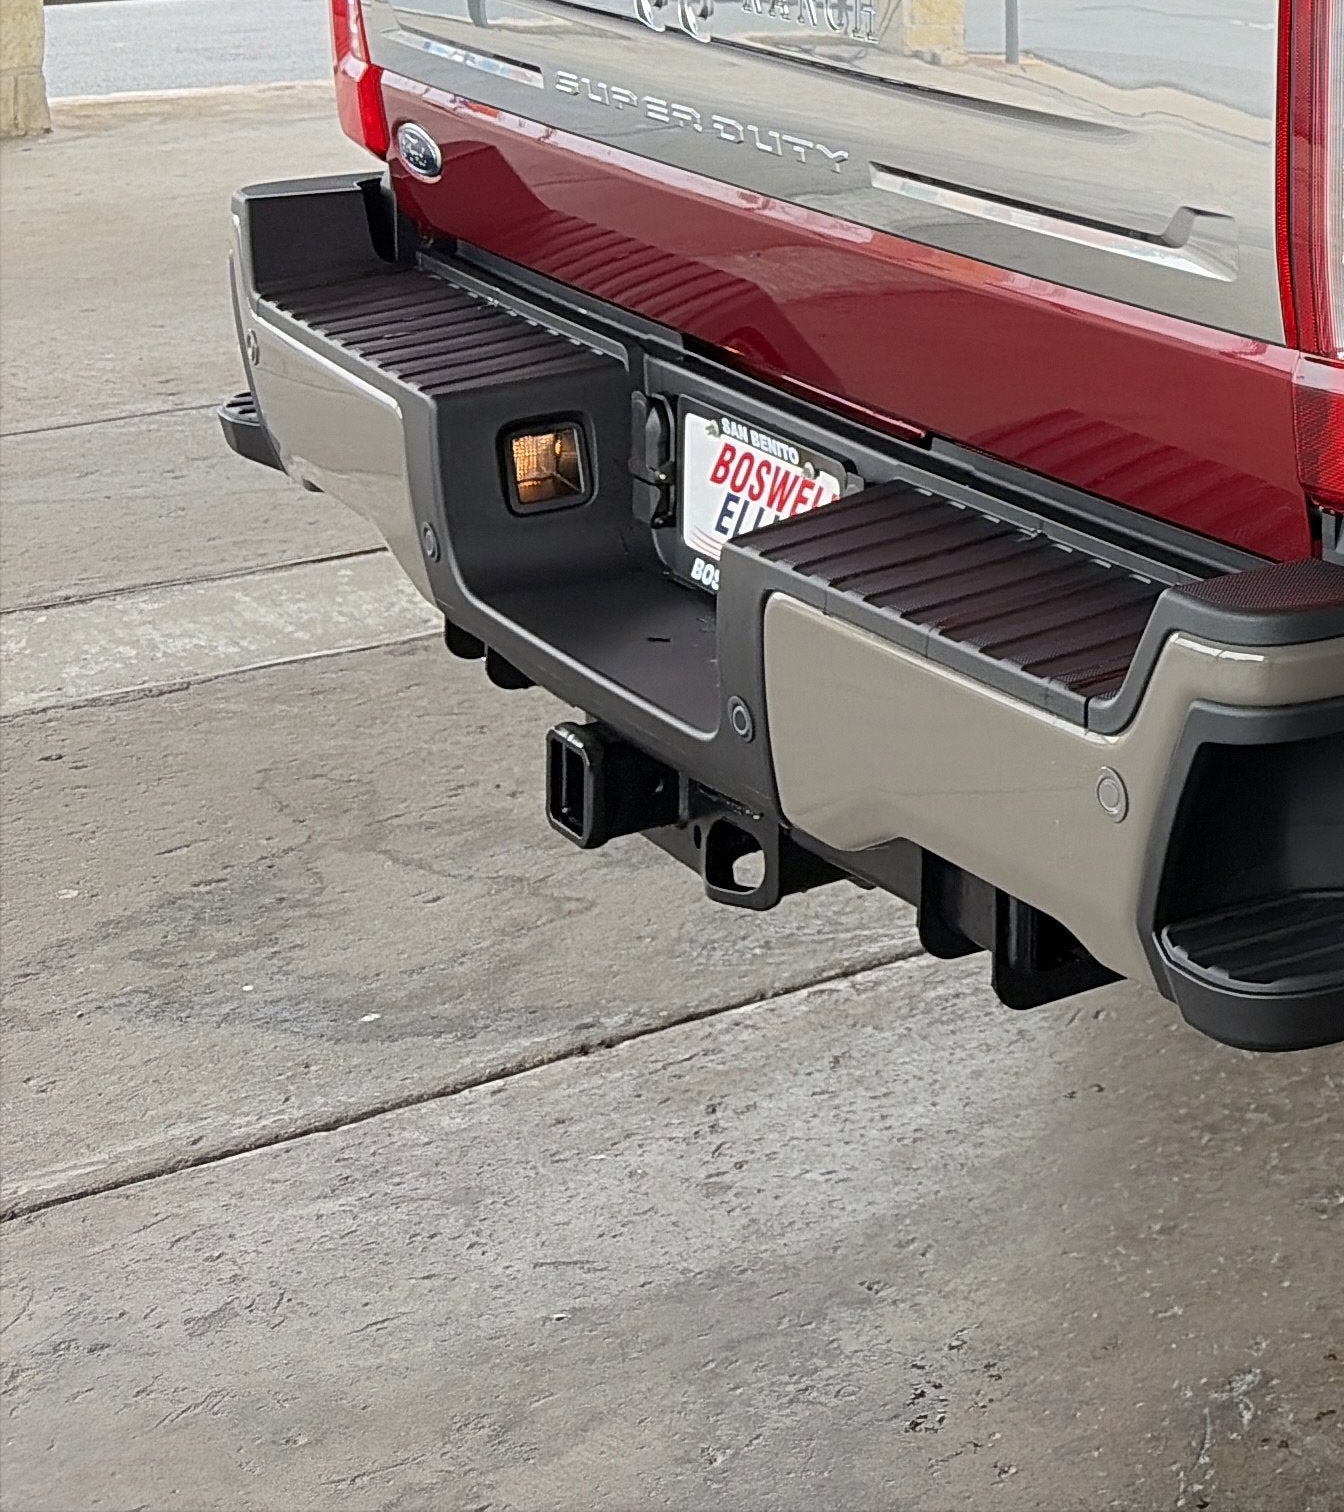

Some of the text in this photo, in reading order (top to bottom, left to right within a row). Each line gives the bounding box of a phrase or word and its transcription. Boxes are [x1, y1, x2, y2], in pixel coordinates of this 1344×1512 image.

[555, 70, 849, 174] SUPER DUTY
[721, 417, 800, 465] SAN BENITO
[709, 443, 841, 517] BOSWEL
